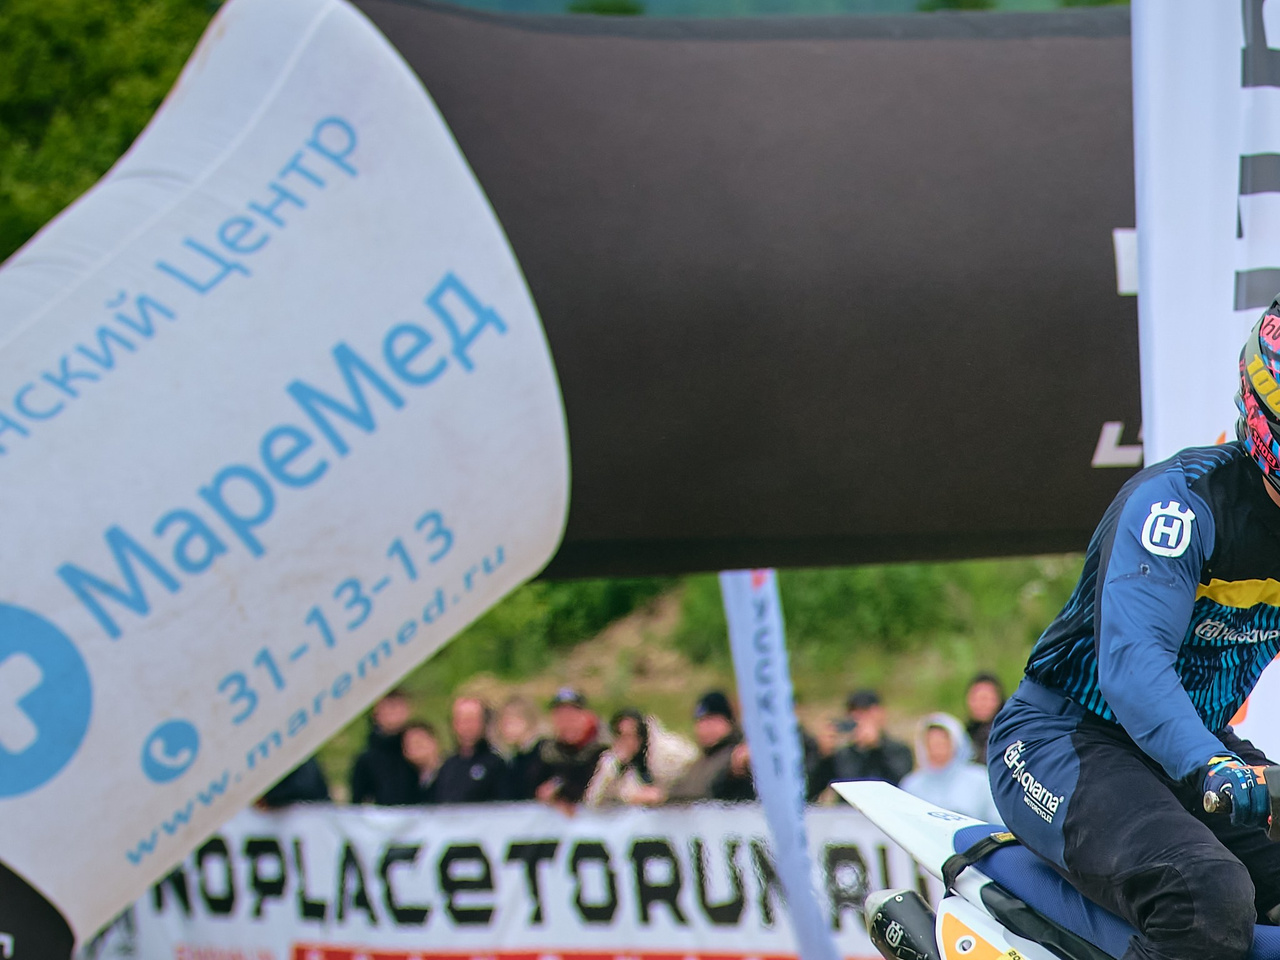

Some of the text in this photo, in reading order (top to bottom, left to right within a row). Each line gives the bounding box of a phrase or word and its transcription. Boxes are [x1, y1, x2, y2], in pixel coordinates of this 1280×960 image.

[154, 115, 360, 296] Центр
[55, 271, 508, 642] МареМед
[1251, 431, 1278, 467] SHOEI
[126, 546, 507, 866] www.maremed.ru
[218, 510, 455, 725] 31-13-13
